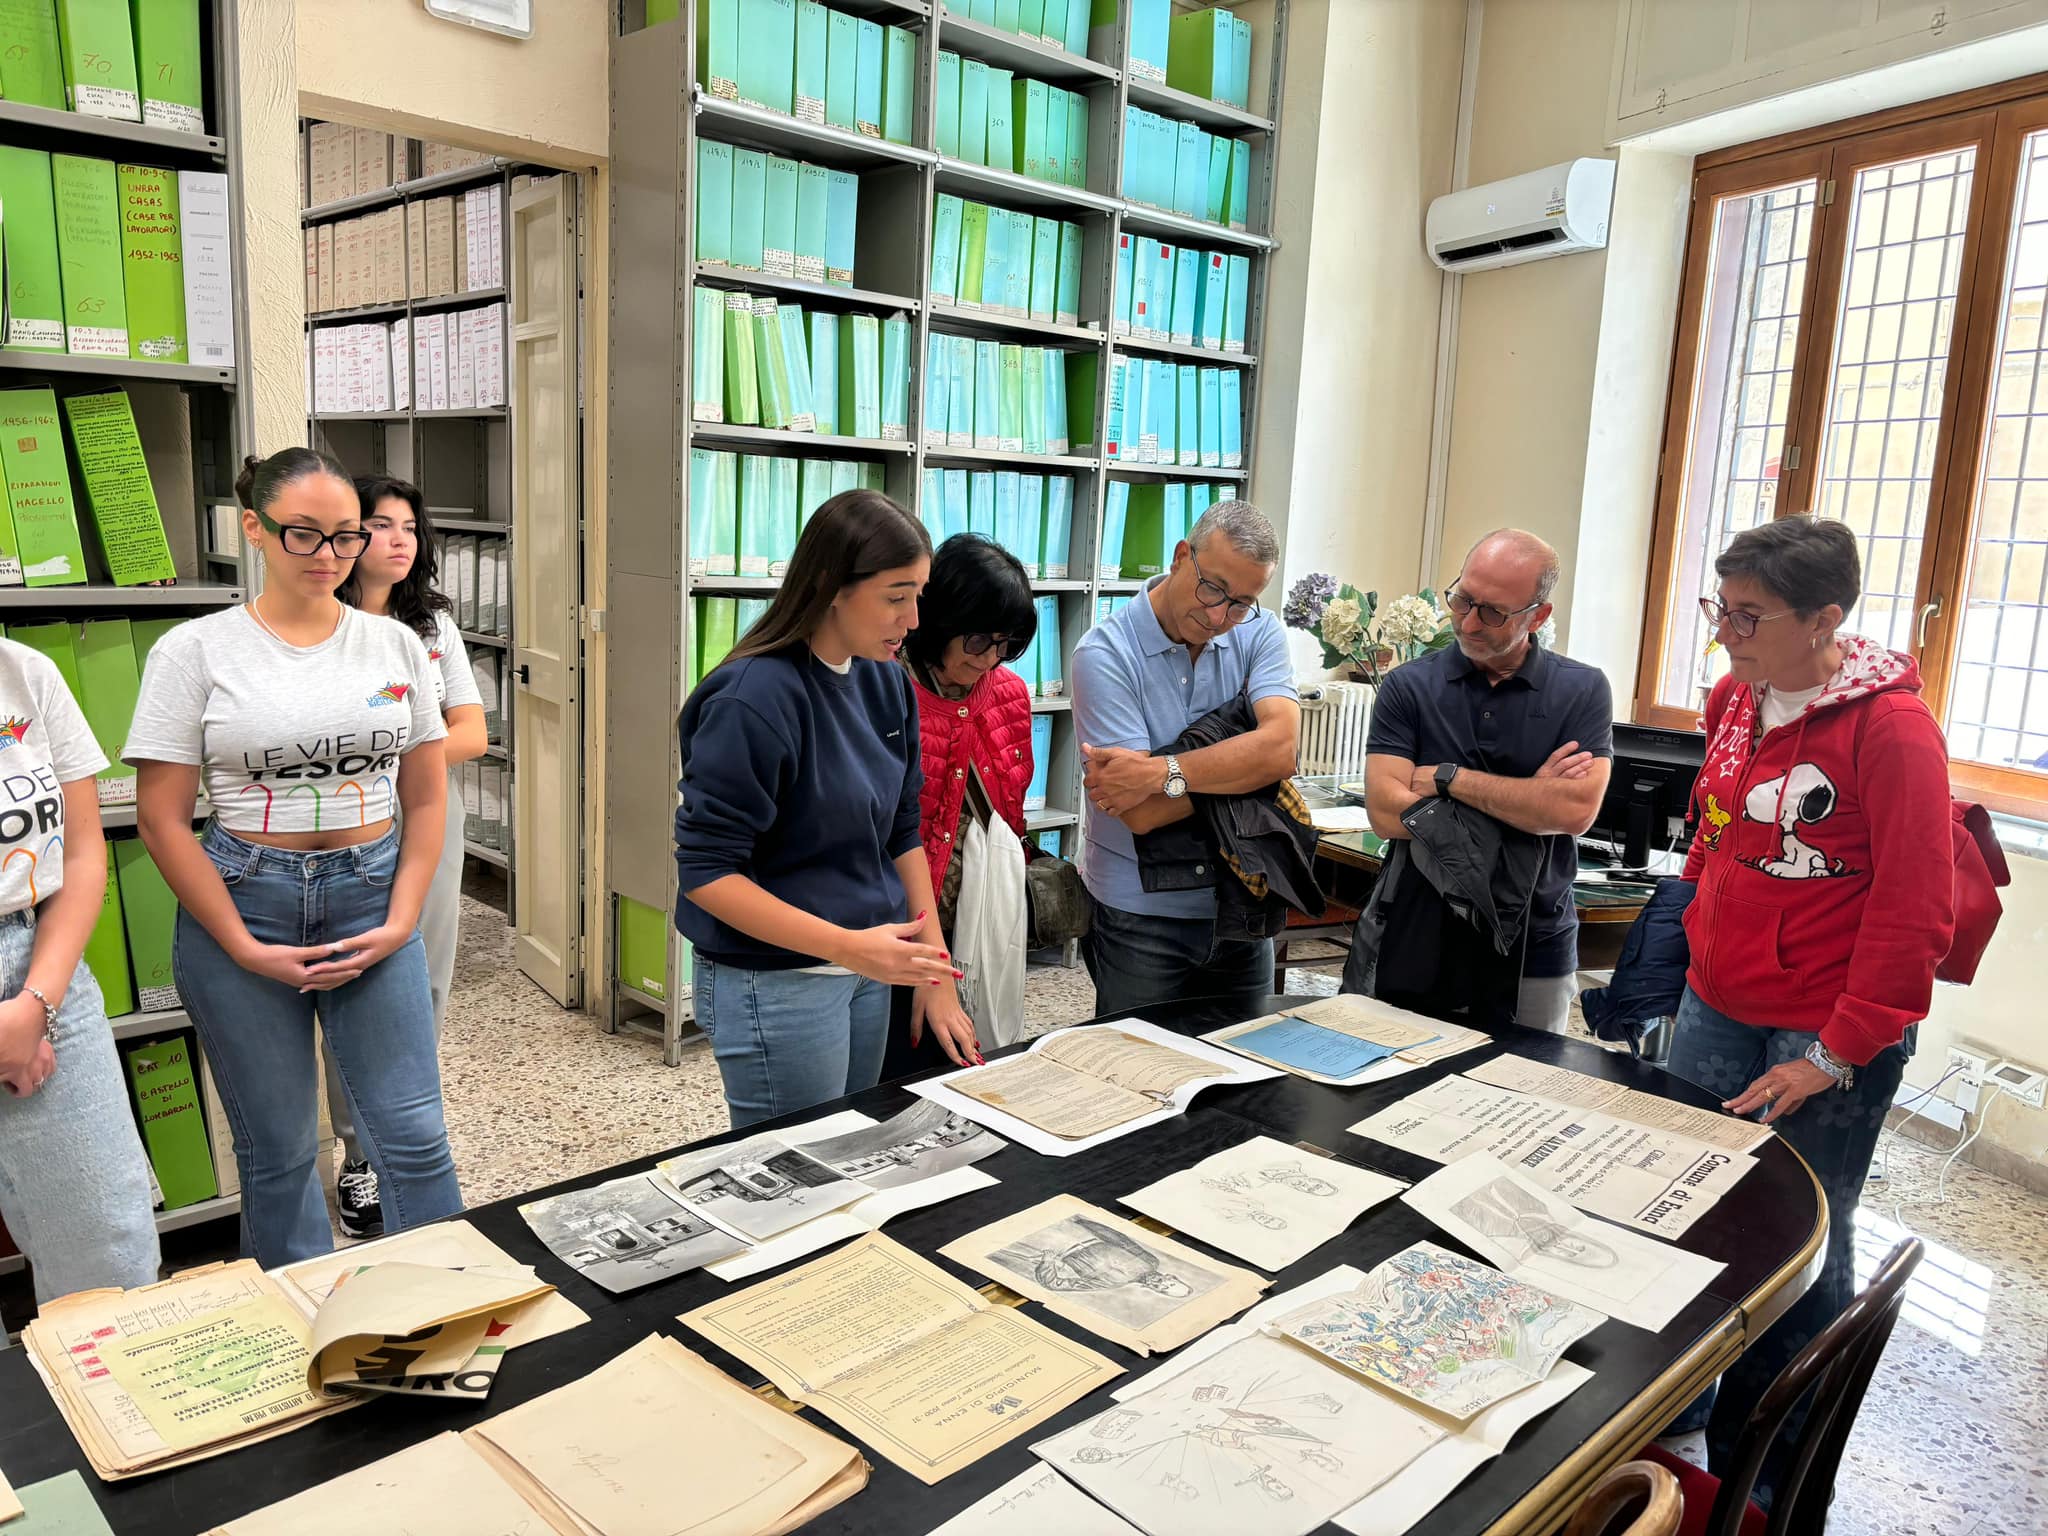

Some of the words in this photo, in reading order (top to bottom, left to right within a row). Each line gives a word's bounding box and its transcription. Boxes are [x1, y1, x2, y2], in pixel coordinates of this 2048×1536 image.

[128, 196, 162, 207] CASAS
[76, 297, 106, 312] 63
[244, 748, 285, 768] LE
[296, 734, 356, 760] VIE
[3, 763, 56, 802] DE
[168, 1052, 182, 1066] 10
[140, 1078, 190, 1100] CASTELLO
[144, 1102, 194, 1124] LOMBARDIA
[1519, 1135, 1566, 1168] SAVARESE
[1681, 1152, 1734, 1189] Comune
[1667, 1188, 1694, 1202] di
[1640, 1198, 1683, 1227] Enna
[182, 1324, 219, 1340] Teatro
[124, 1337, 178, 1358] Comunale
[149, 1371, 191, 1388] COLORI
[193, 1376, 220, 1389] DELLA
[982, 1365, 1043, 1400] MUNICIPIO
[160, 1389, 186, 1401] FESTA
[967, 1398, 984, 1408] DI
[268, 1396, 303, 1415] ARTISTICI
[241, 1408, 266, 1424] PREMI
[932, 1407, 969, 1428] ENNA
